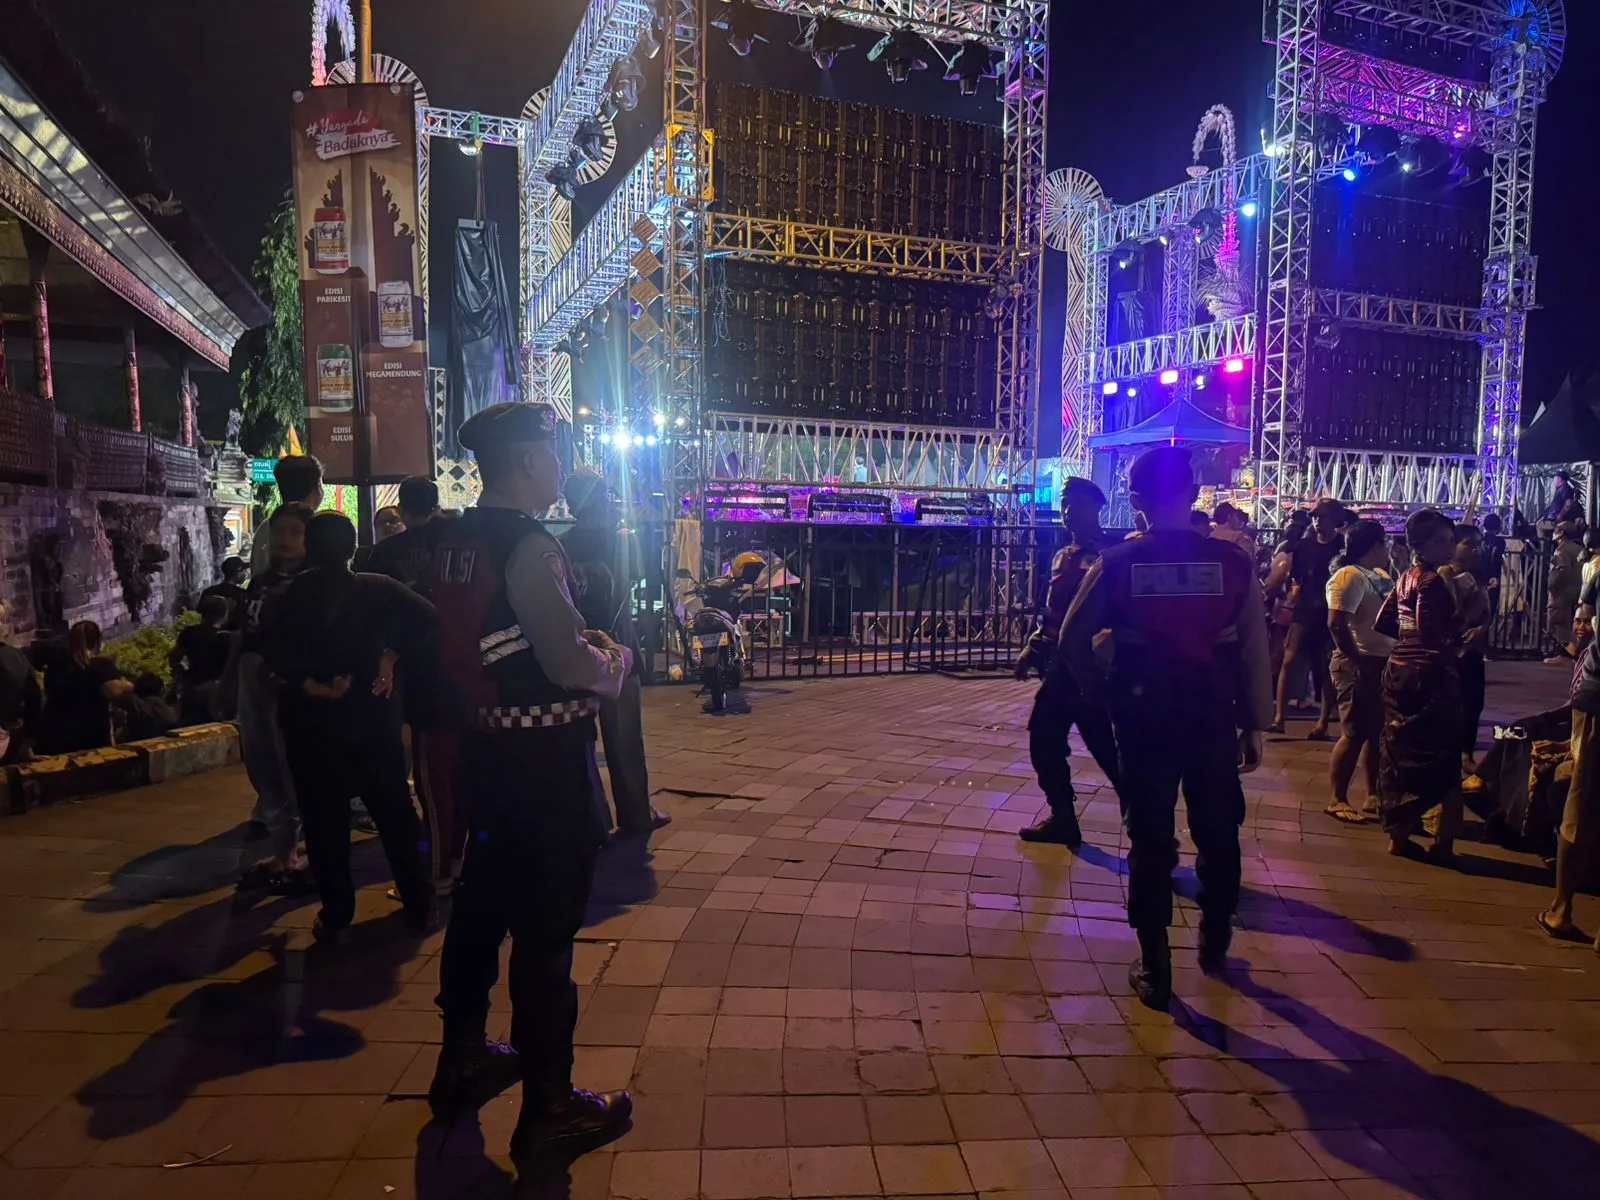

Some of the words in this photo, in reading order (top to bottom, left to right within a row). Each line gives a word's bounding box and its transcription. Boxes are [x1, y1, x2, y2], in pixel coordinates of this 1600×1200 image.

[324, 133, 388, 154] Badaknya
[324, 288, 344, 296] EDISI
[316, 296, 352, 304] PARIKESIT
[366, 370, 422, 378] MEGAMENDUNG
